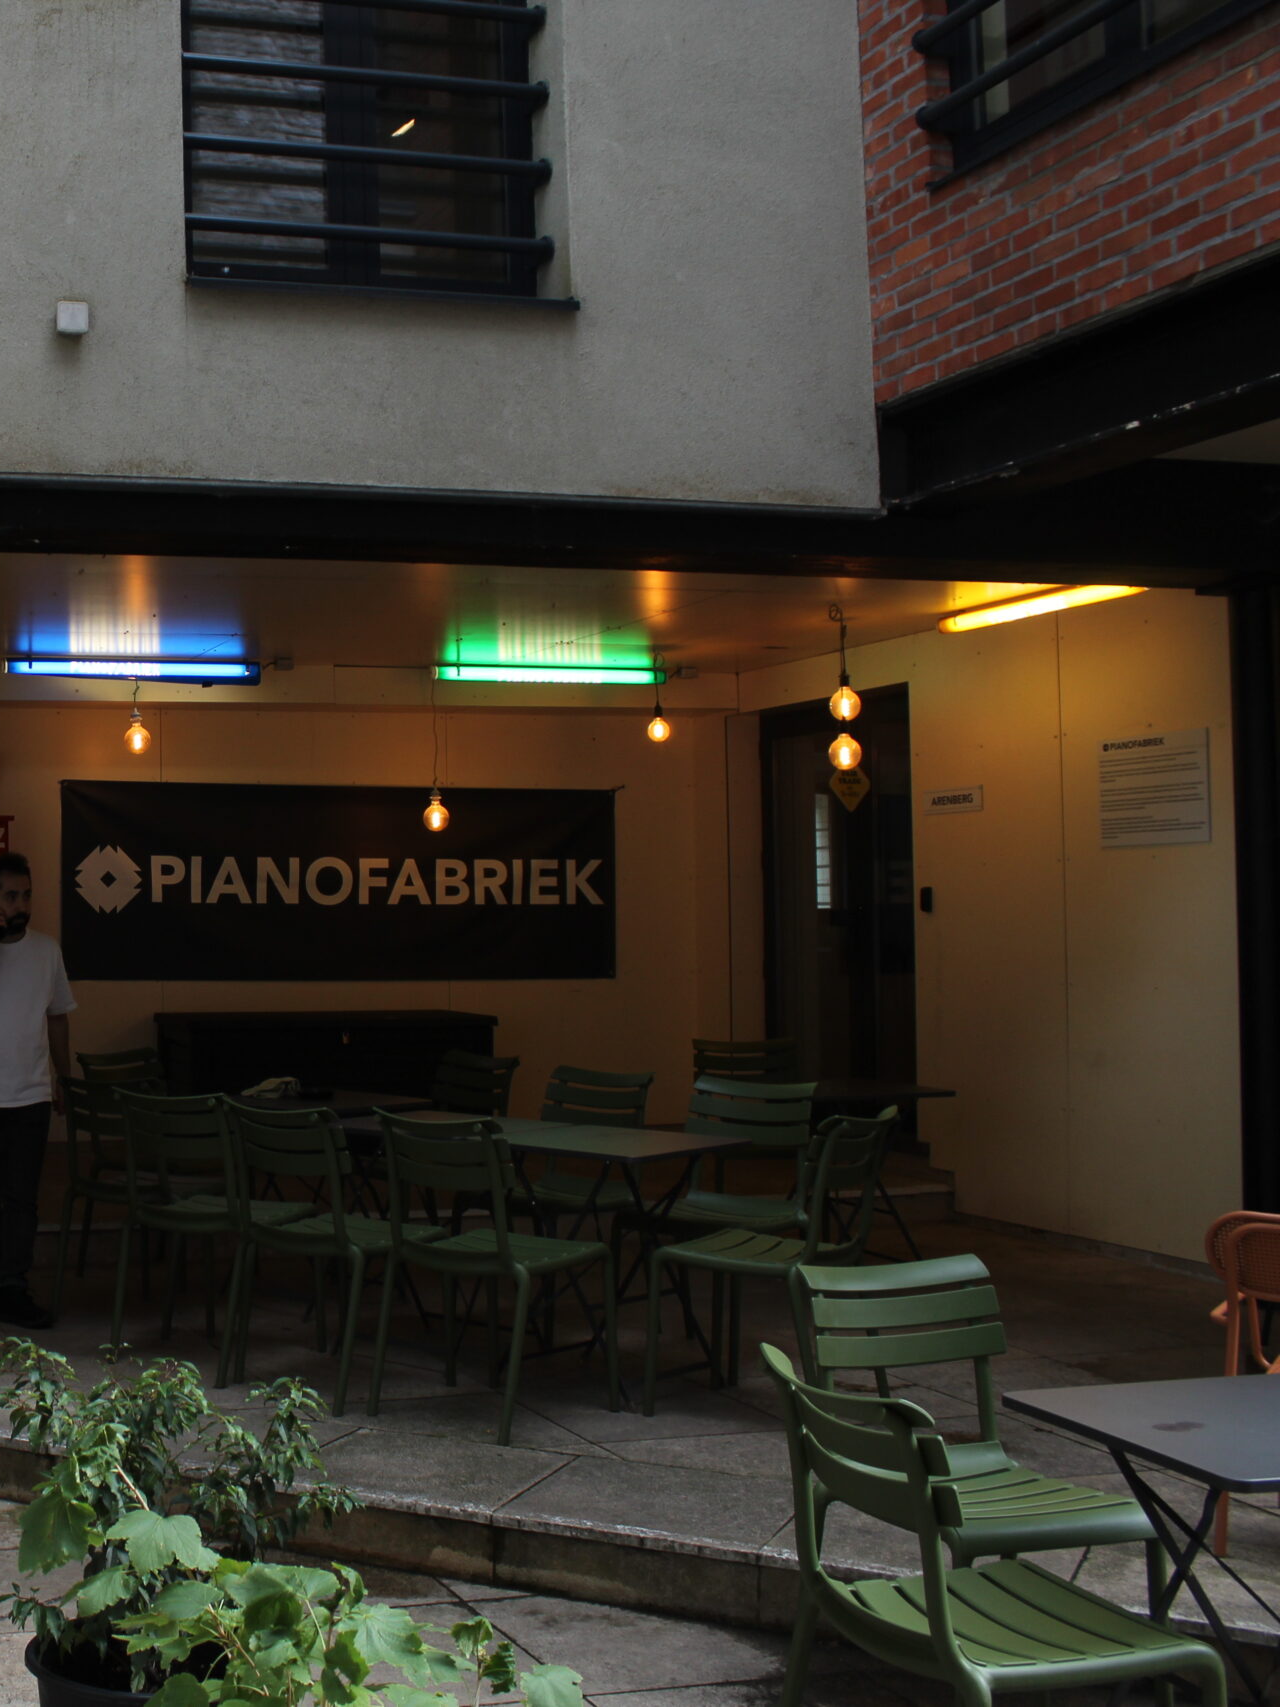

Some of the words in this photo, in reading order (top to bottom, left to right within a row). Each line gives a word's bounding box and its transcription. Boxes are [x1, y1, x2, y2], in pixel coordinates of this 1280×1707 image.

[1109, 738, 1164, 751] PIANOFABRIEK
[931, 793, 973, 806] ARENBERG
[150, 855, 605, 906] PIANOFABRIEK
